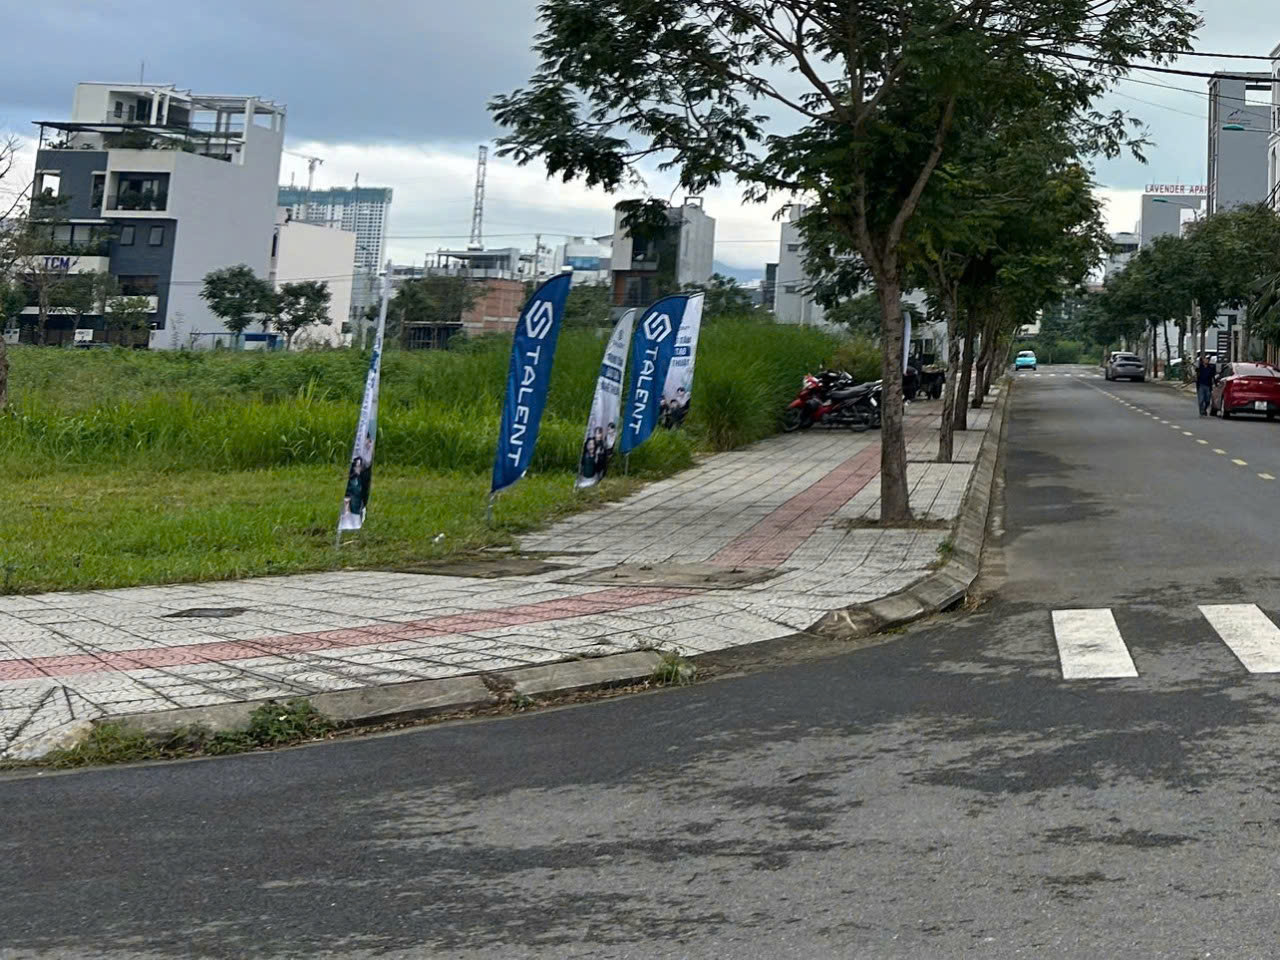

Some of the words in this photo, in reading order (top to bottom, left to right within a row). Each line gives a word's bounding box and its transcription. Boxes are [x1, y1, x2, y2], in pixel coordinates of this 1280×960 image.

[1145, 183, 1185, 193] LAVENDER
[44, 256, 71, 270] TCM
[507, 345, 541, 467] TALENT
[628, 346, 660, 435] TALENT
